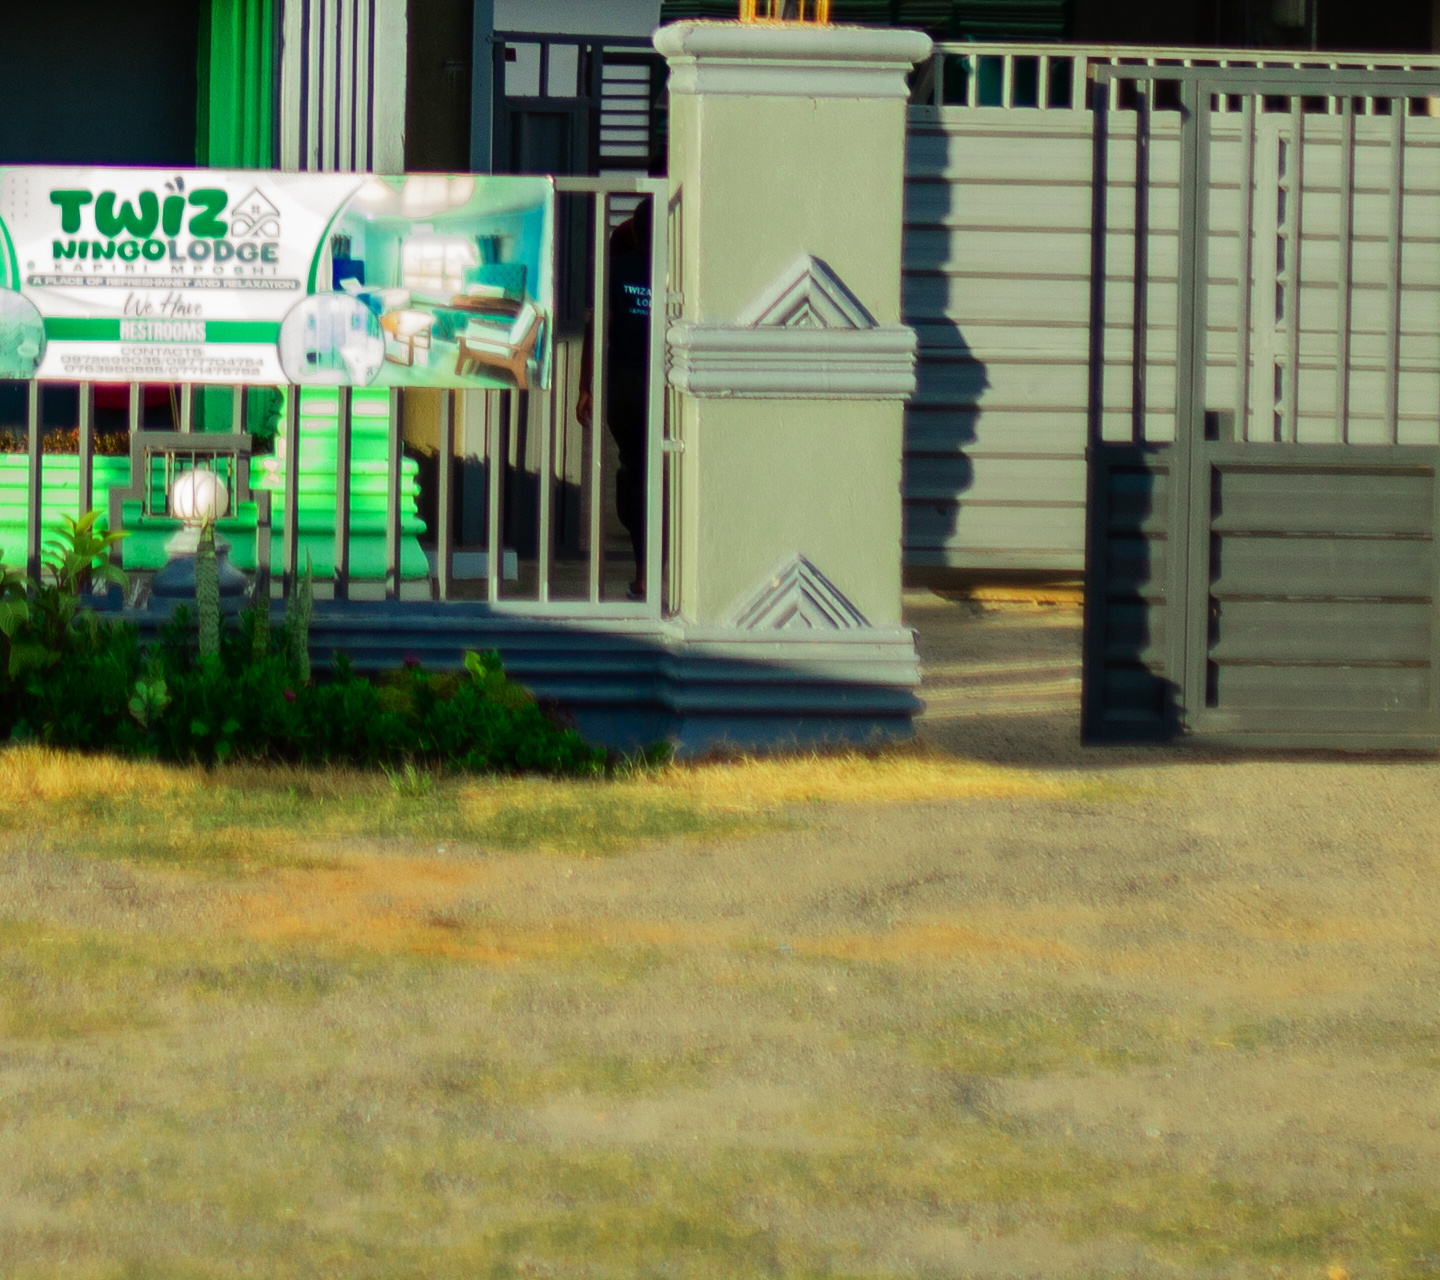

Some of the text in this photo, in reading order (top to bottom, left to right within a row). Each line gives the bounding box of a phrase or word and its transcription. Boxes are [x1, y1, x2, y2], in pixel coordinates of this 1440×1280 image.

[55, 263, 277, 275] KAPIRI MPOSHI
[32, 277, 42, 285] A
[45, 277, 83, 286] PLACE
[86, 277, 103, 286] OF
[194, 279, 221, 288] AND
[223, 280, 296, 289] RELAXATION
[124, 291, 203, 318] We Have
[120, 320, 206, 341] RESTROOMS
